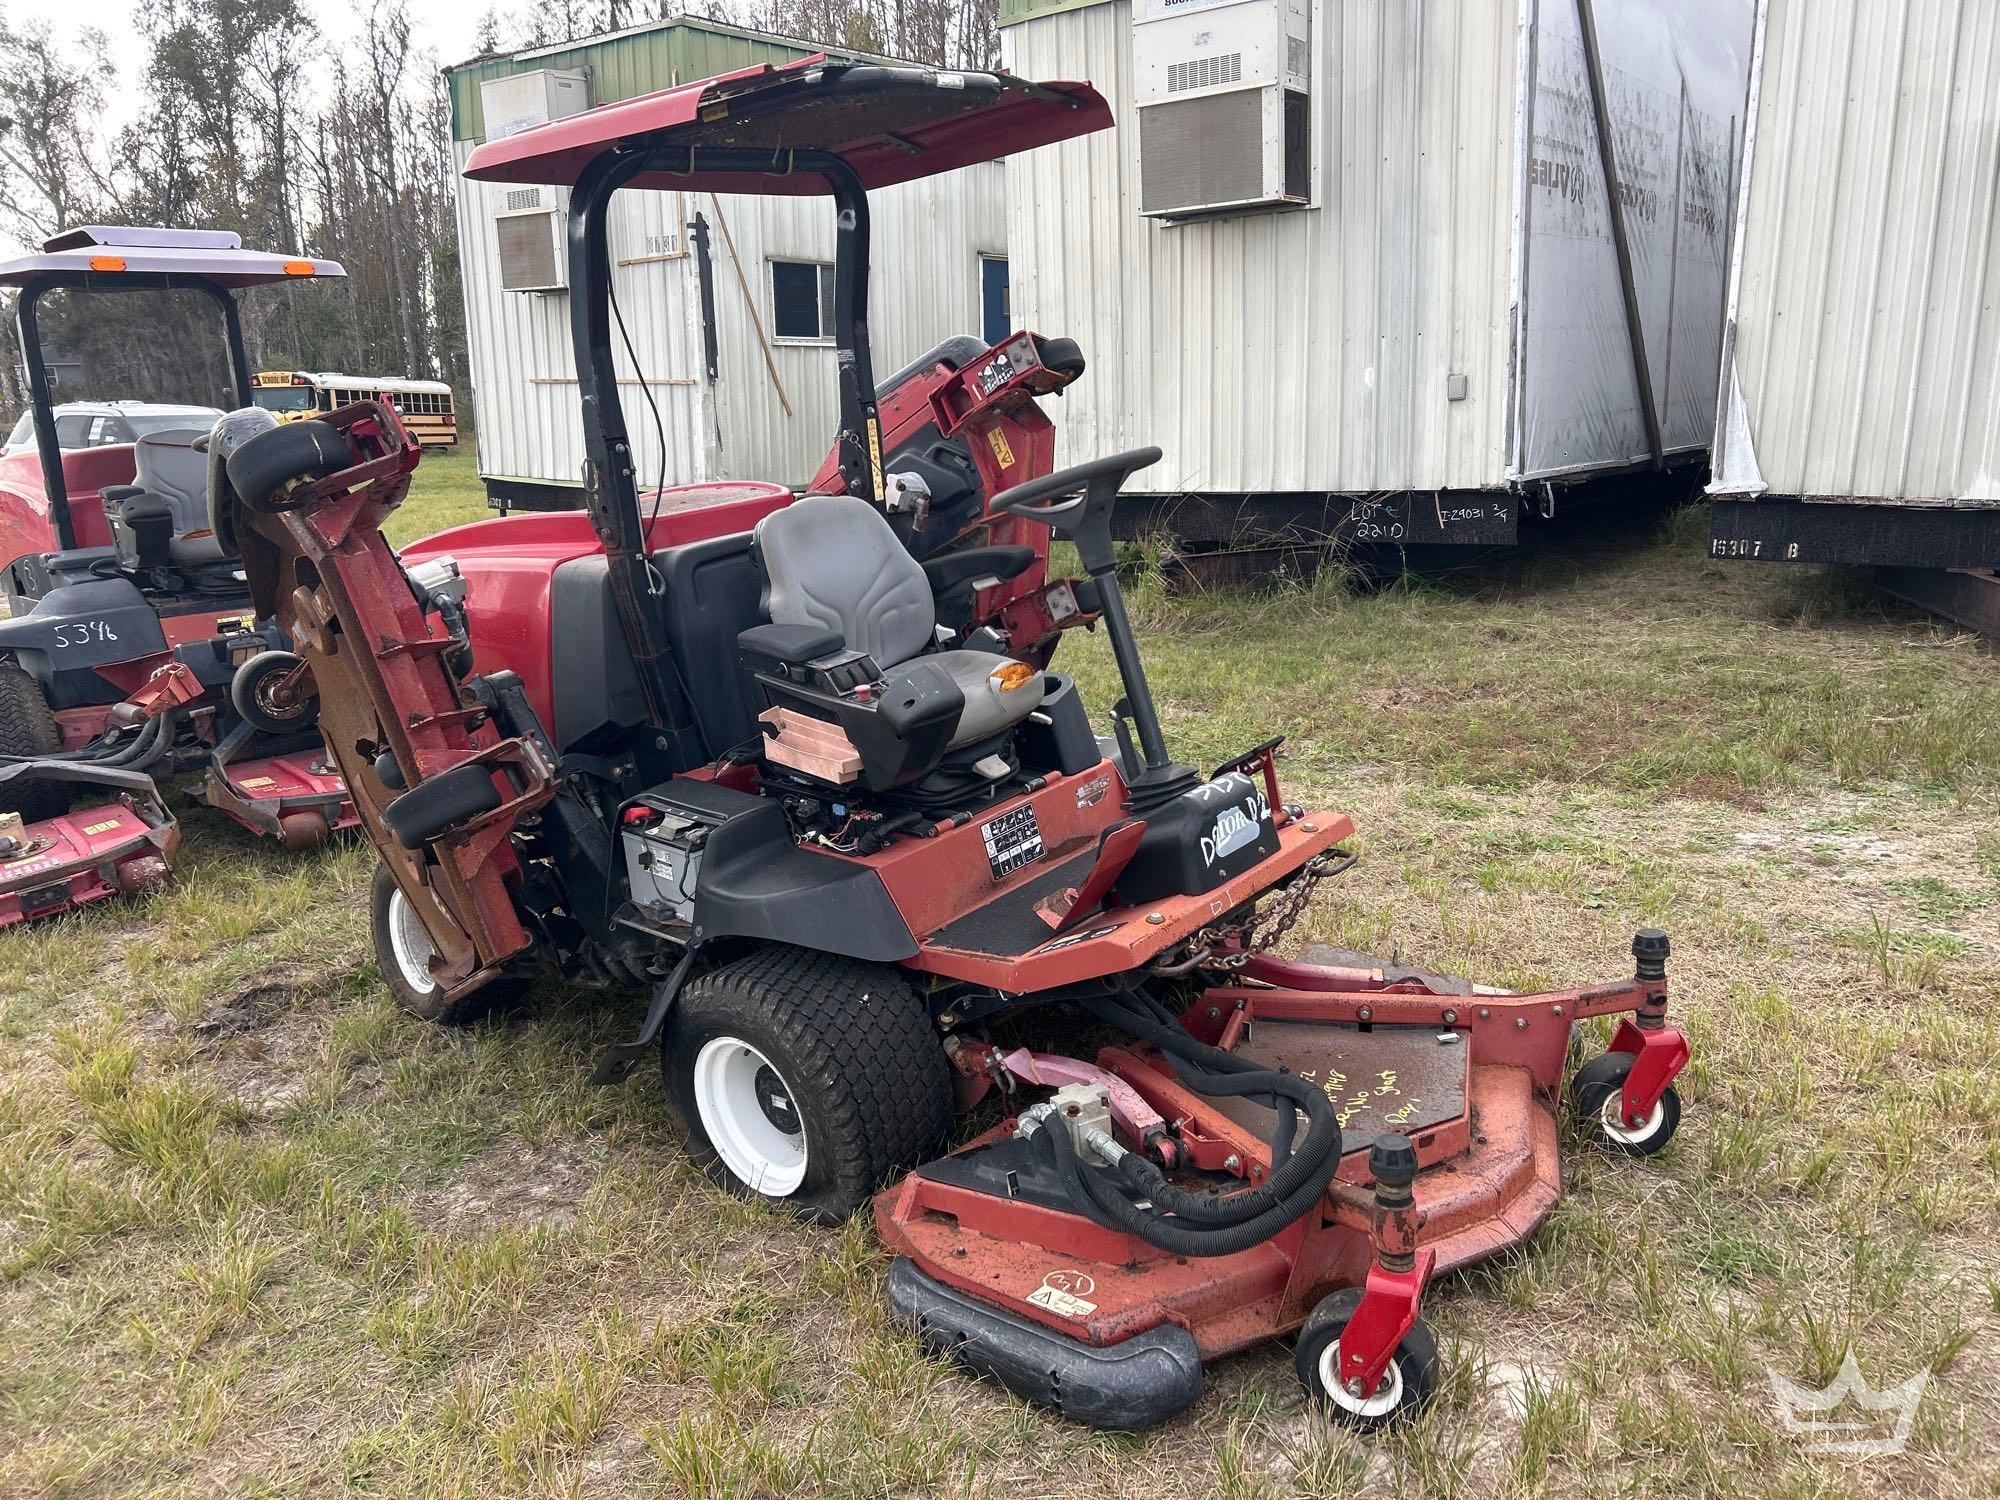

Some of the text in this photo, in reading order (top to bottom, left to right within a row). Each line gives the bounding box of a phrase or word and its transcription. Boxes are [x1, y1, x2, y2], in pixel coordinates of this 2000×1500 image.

[261, 375, 290, 385] SCHOOL BUS
[53, 621, 118, 648] 5346
